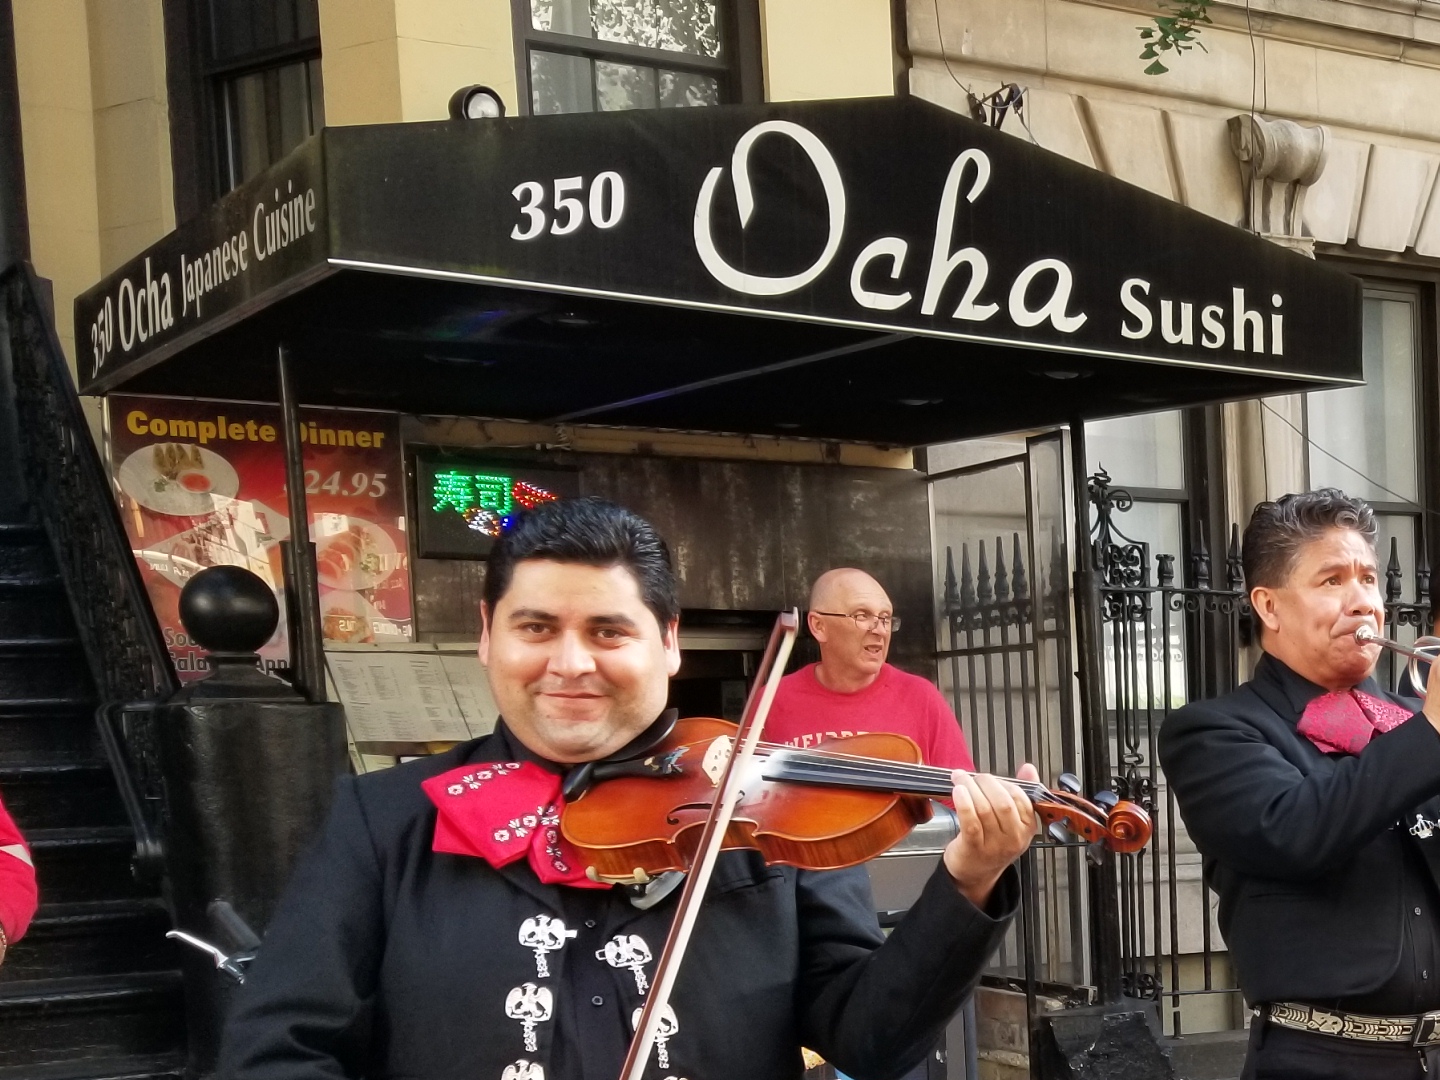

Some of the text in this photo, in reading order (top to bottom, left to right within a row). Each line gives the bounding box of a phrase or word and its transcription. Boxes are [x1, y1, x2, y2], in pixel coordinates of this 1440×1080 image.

[510, 120, 1285, 356] 350 Ocha Sushi
[91, 179, 316, 379] 350 Ocha Japanese Cuisine
[126, 410, 277, 444] Complete
[283, 470, 387, 498] 24.95
[432, 470, 512, 516] 寿司
